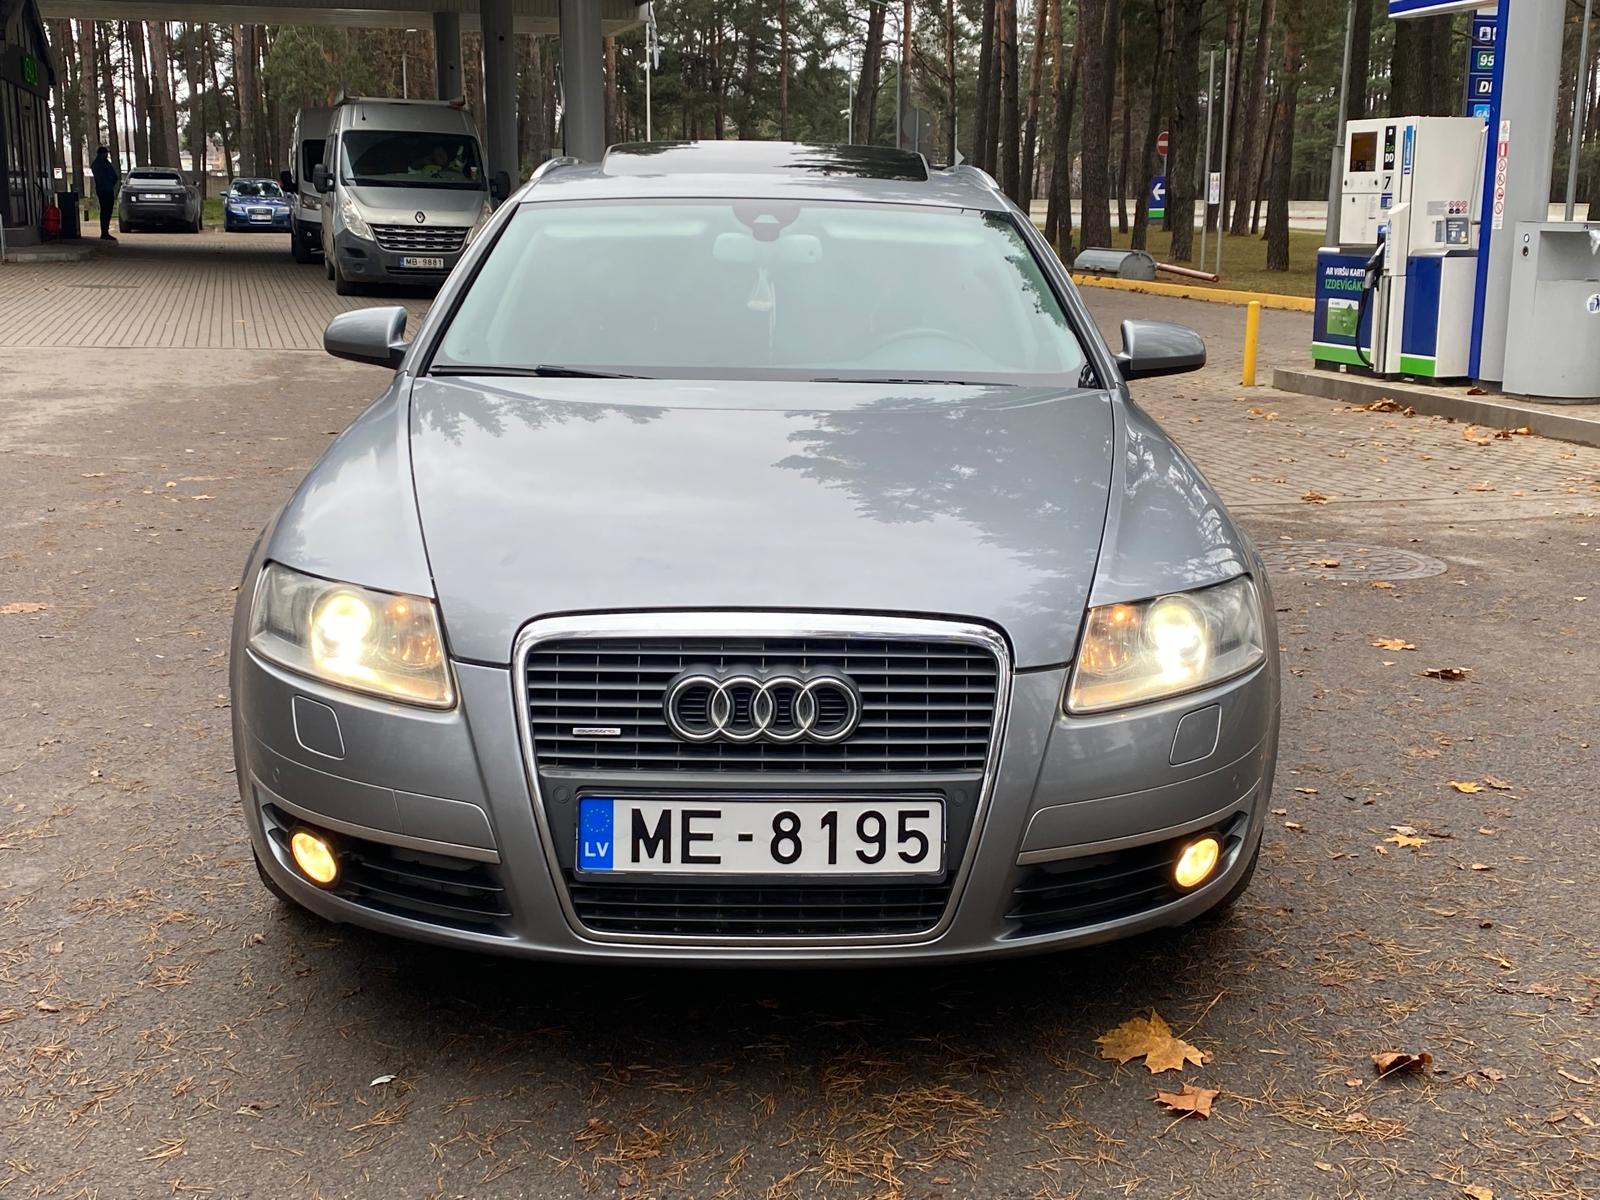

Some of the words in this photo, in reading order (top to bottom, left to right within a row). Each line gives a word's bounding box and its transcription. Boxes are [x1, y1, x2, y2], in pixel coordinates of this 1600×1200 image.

[1480, 54, 1494, 66] 95
[1384, 175, 1392, 190] 7
[1325, 267, 1334, 275] AR
[1333, 266, 1350, 277] VIRŠU
[630, 808, 931, 865] ME-8195
[584, 841, 610, 858] LV
